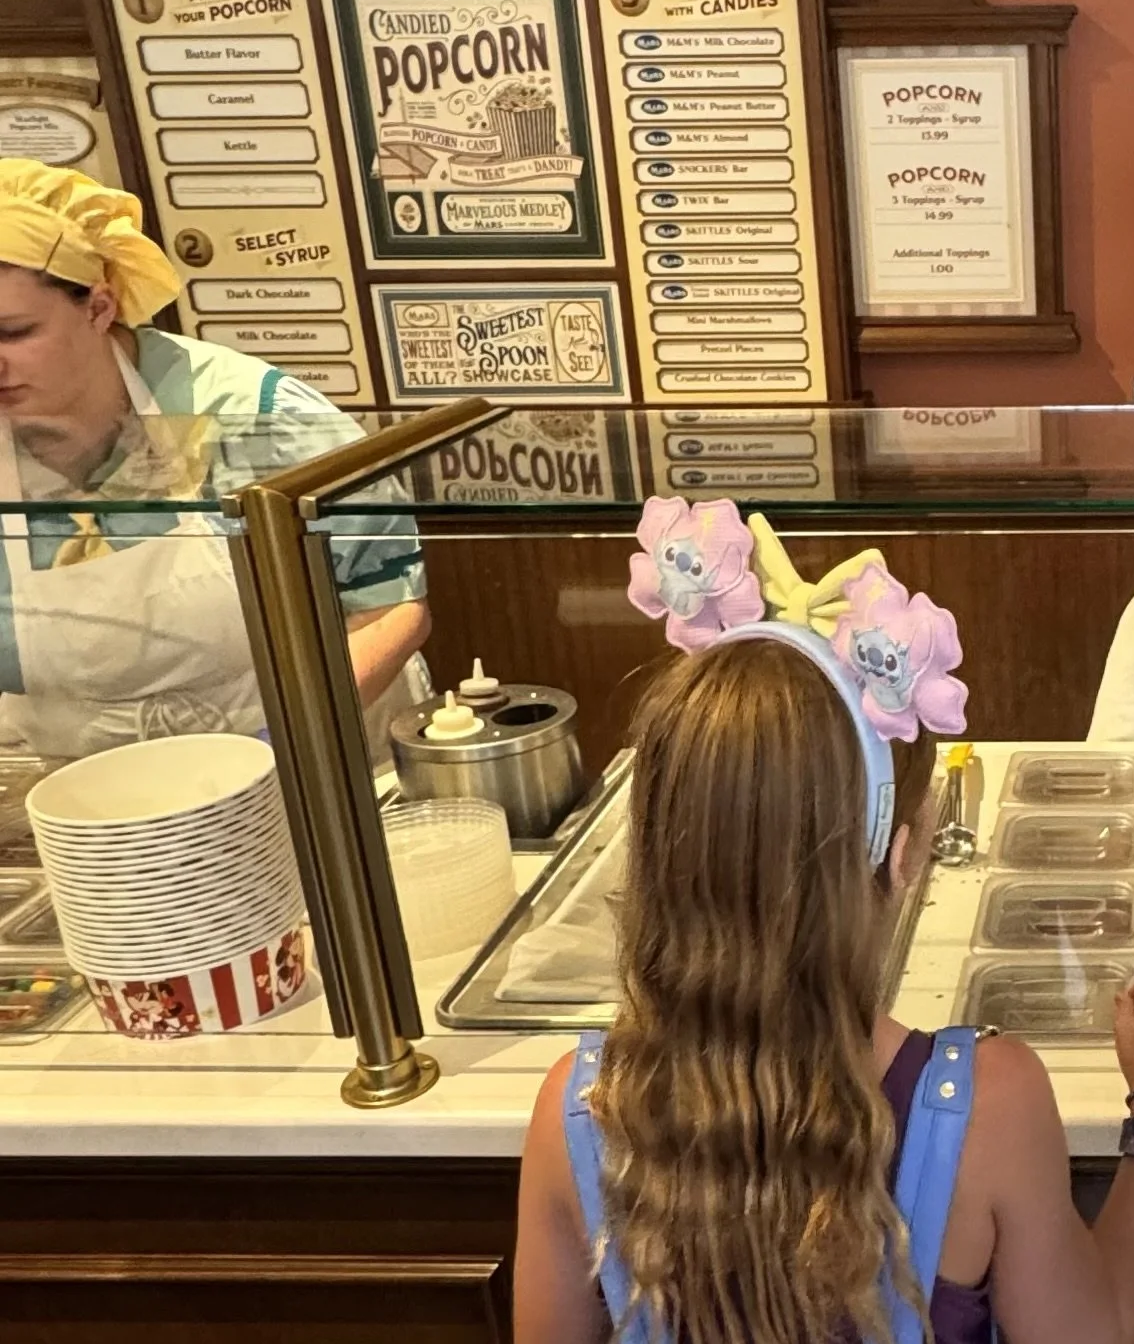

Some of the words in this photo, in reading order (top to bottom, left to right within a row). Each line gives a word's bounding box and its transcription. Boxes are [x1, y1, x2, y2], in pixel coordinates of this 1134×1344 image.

[173, 10, 206, 24] YOUR
[665, 6, 694, 17] WITH
[704, 37, 724, 47] Milk
[727, 37, 775, 47] Chocolate
[373, 22, 551, 118] POPCORN
[706, 69, 740, 79] Peanut
[207, 93, 255, 105] Caramel
[882, 84, 983, 107] POPCORN
[887, 114, 894, 124] 2
[897, 114, 943, 125] Toppings
[952, 113, 982, 125] Syrup
[411, 128, 458, 148] POPCORN
[712, 133, 749, 143] Almond
[222, 140, 258, 152] Kettle
[474, 167, 506, 181] TREAT
[534, 158, 573, 173] DANDY!
[677, 164, 728, 174] SNICKERS
[732, 164, 749, 174] Bar
[887, 165, 987, 189] POPCORN
[713, 196, 730, 205] Bar
[902, 195, 946, 206] Toppings
[955, 194, 985, 206] Syrup
[445, 201, 517, 222] MARVELOUS
[519, 200, 567, 220] MEDLEY
[685, 226, 732, 236] SKITTLES
[735, 225, 773, 237] Original
[234, 228, 297, 252] SELECT
[182, 234, 203, 260] 2
[275, 245, 331, 267] SYRUP
[893, 248, 943, 258] Additional
[946, 248, 991, 259] Toppings
[738, 256, 760, 266] Sour
[225, 288, 253, 299] Dark
[255, 288, 311, 299] Chocolate
[762, 287, 801, 298] Original
[560, 314, 593, 332] TASTE
[235, 331, 259, 341] Milk
[262, 330, 318, 341] Chocolate
[401, 339, 454, 359] SWEETEST
[404, 360, 418, 369] OF
[478, 342, 550, 375] SPOON
[407, 370, 458, 386] ALL?
[463, 367, 553, 383] SHOWCASE
